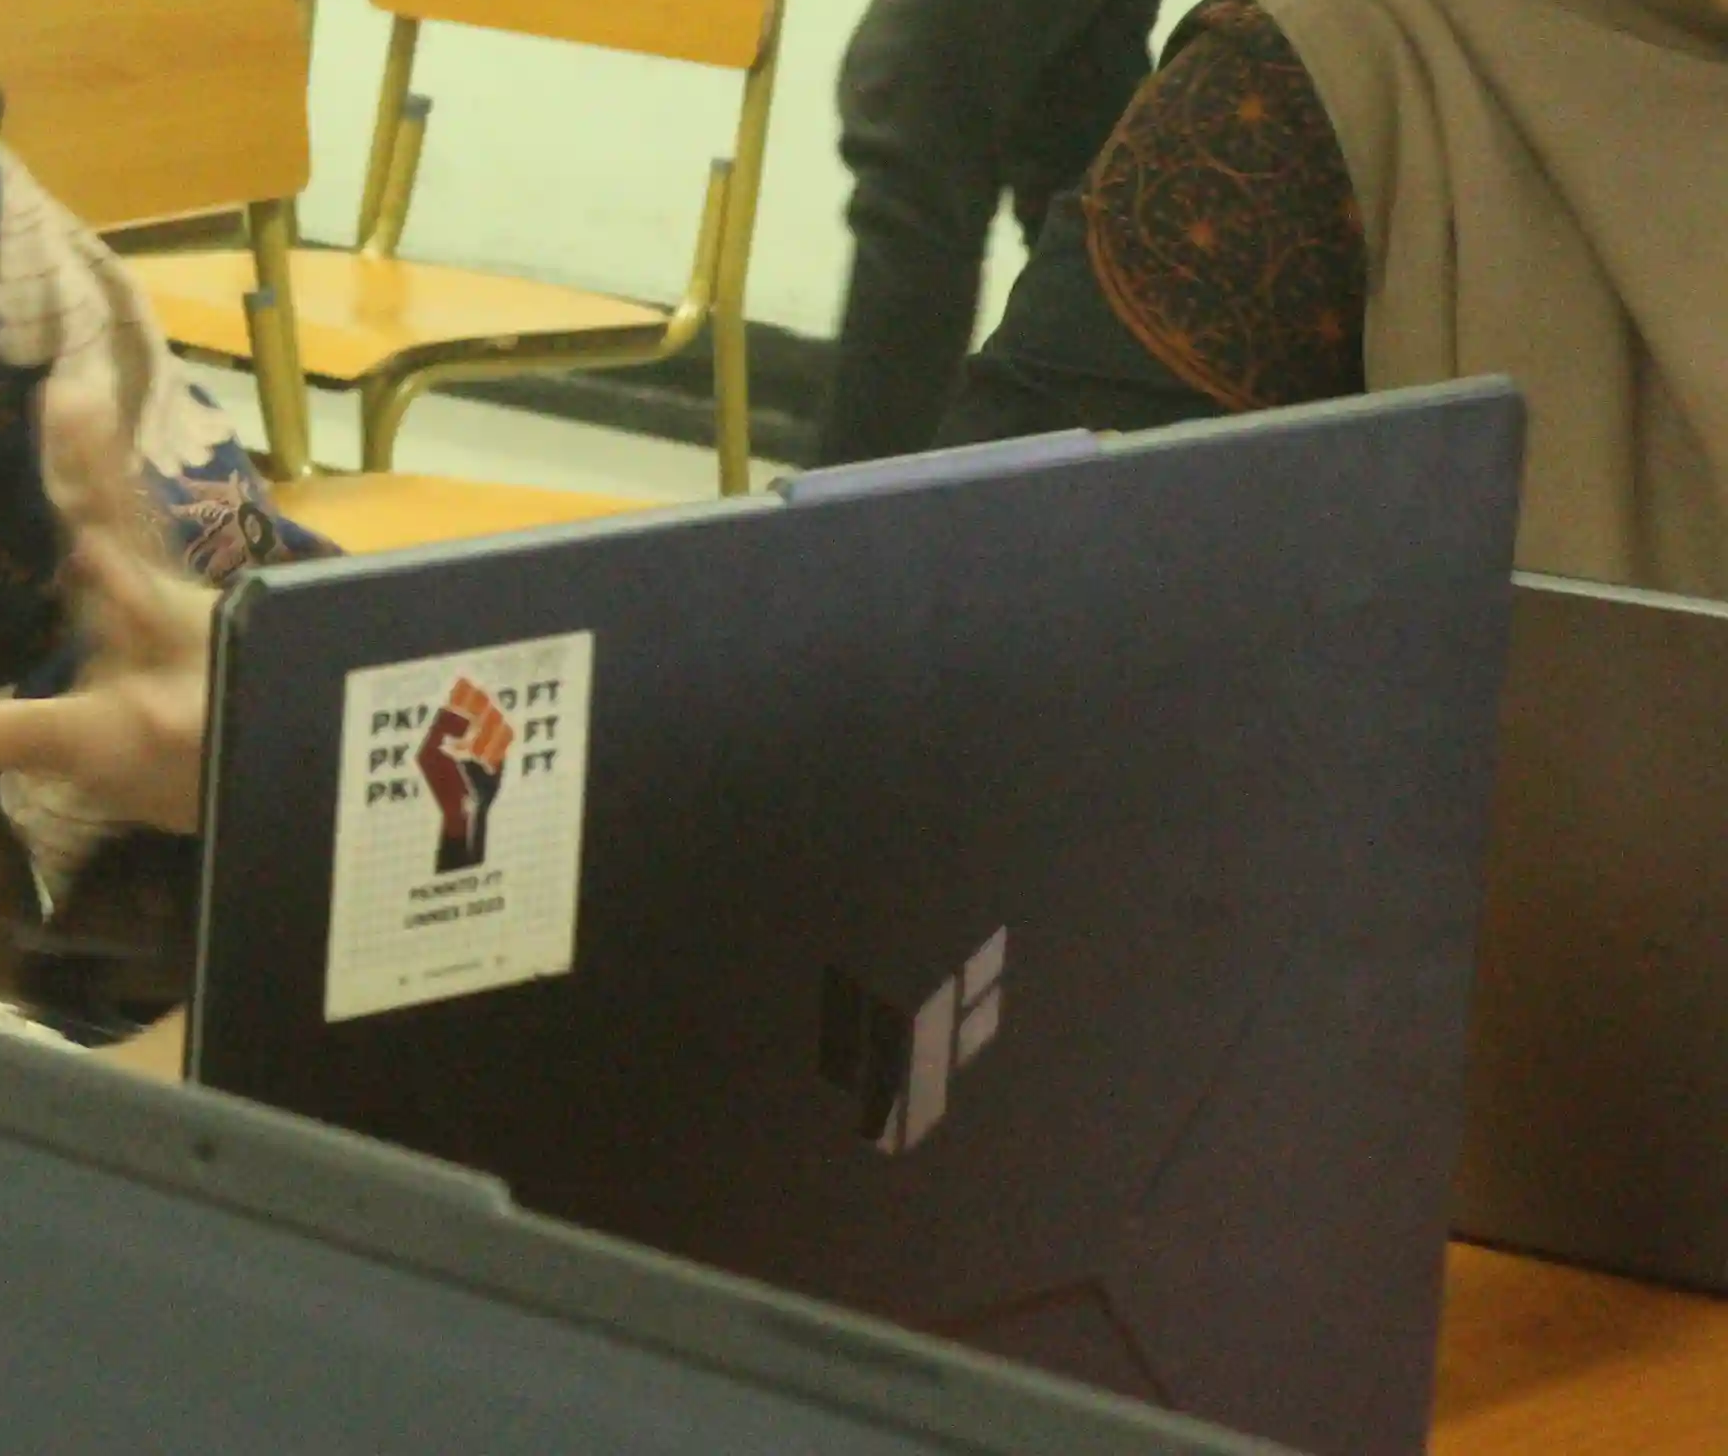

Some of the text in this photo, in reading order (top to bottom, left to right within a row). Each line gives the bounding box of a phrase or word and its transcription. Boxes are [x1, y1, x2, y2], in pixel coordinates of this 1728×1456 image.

[527, 680, 560, 706] FT
[524, 716, 559, 743] FT
[522, 749, 556, 775] FT
